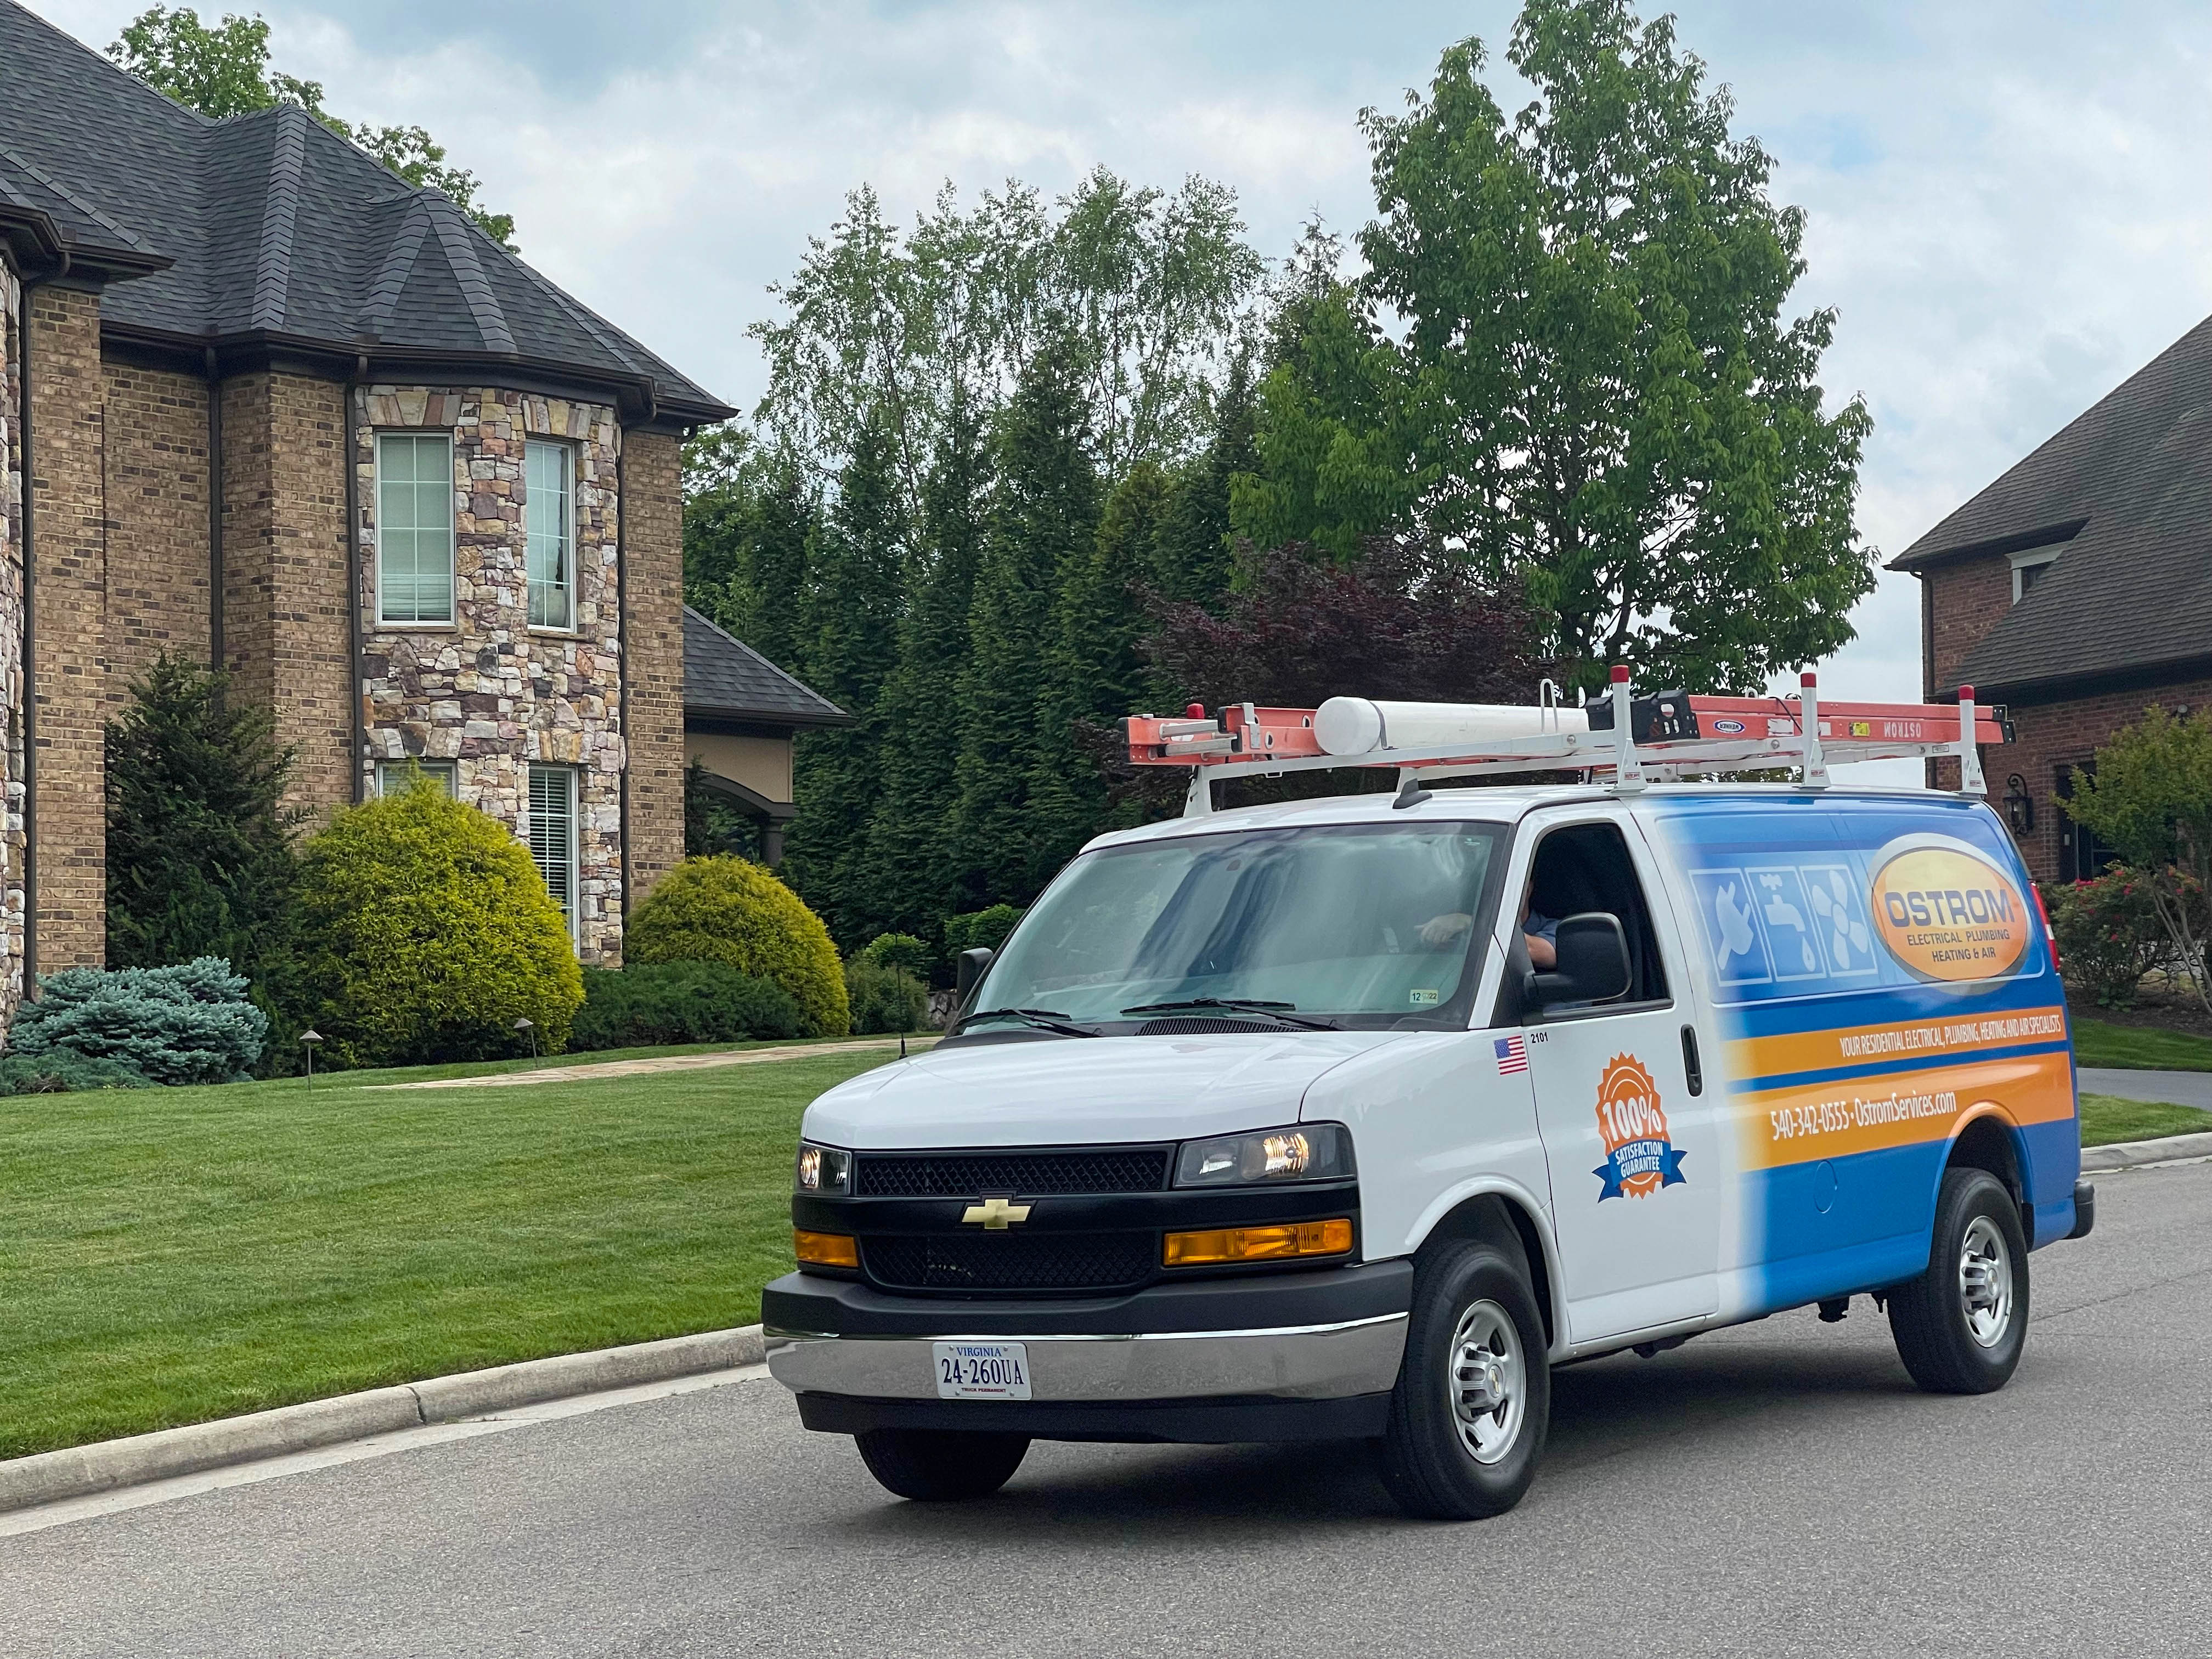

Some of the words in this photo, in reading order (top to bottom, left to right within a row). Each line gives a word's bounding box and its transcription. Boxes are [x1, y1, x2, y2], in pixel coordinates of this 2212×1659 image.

[1884, 721, 1921, 738] OSTROM
[1884, 889, 2015, 927] OSTROM
[1906, 932, 1963, 946] ELECTRICAL
[1966, 929, 2010, 943] PLUMBING
[1932, 949, 1971, 962] HEATING
[1973, 950, 1979, 959] &
[1982, 947, 1996, 958] AIR
[1412, 992, 1421, 1001] 12
[1531, 1031, 1548, 1043] 2101
[1839, 1036, 1862, 1058] YOUR
[1860, 1031, 1906, 1055] RESIDENTIAL
[1904, 1026, 1945, 1049] ELECTRICAL,
[1944, 1023, 1981, 1045] PLUMBING,
[1979, 1020, 2007, 1041] HEATING
[2006, 1018, 2019, 1038] AND
[2019, 1017, 2030, 1036] AIR
[2029, 1014, 2061, 1035] SPECIALISTS
[1602, 1093, 1662, 1142] 100%
[1770, 1100, 1849, 1141] 540-342-0555
[1854, 1090, 1957, 1127] OstromServices.com
[1615, 1141, 1663, 1165] SATISFACTION
[1621, 1156, 1660, 1178] GUARANTEE
[956, 1347, 1002, 1357] VIRGINIA
[941, 1358, 1024, 1385] 24-260UA
